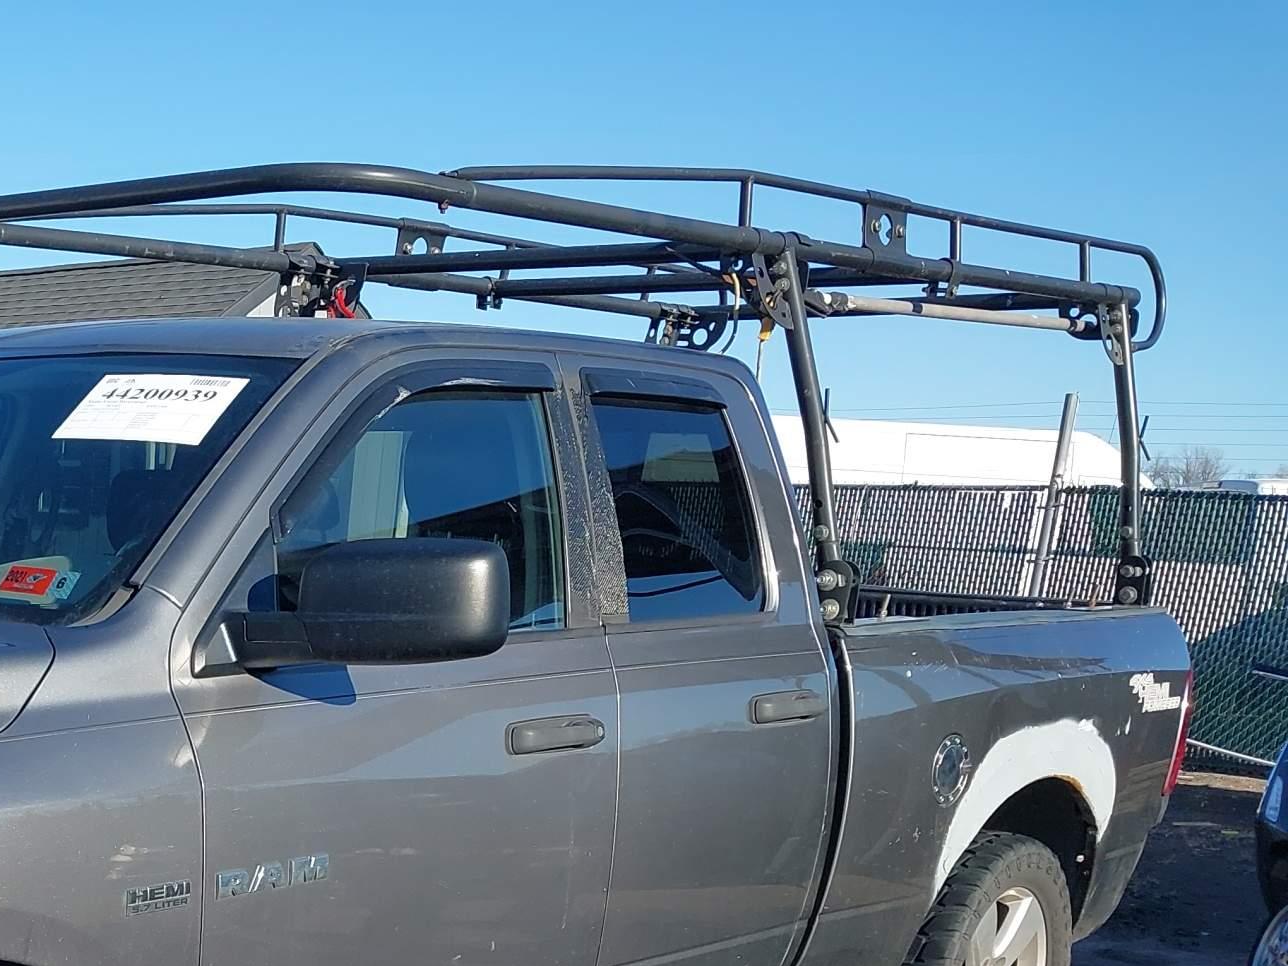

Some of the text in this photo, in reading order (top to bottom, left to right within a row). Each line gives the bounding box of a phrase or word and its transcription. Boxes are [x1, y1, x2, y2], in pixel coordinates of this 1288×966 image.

[101, 387, 218, 403] 44200939
[55, 577, 67, 589] 6
[215, 854, 330, 900] RAM
[127, 880, 192, 906] HEMI
[130, 897, 188, 914] 5.7 LITER
